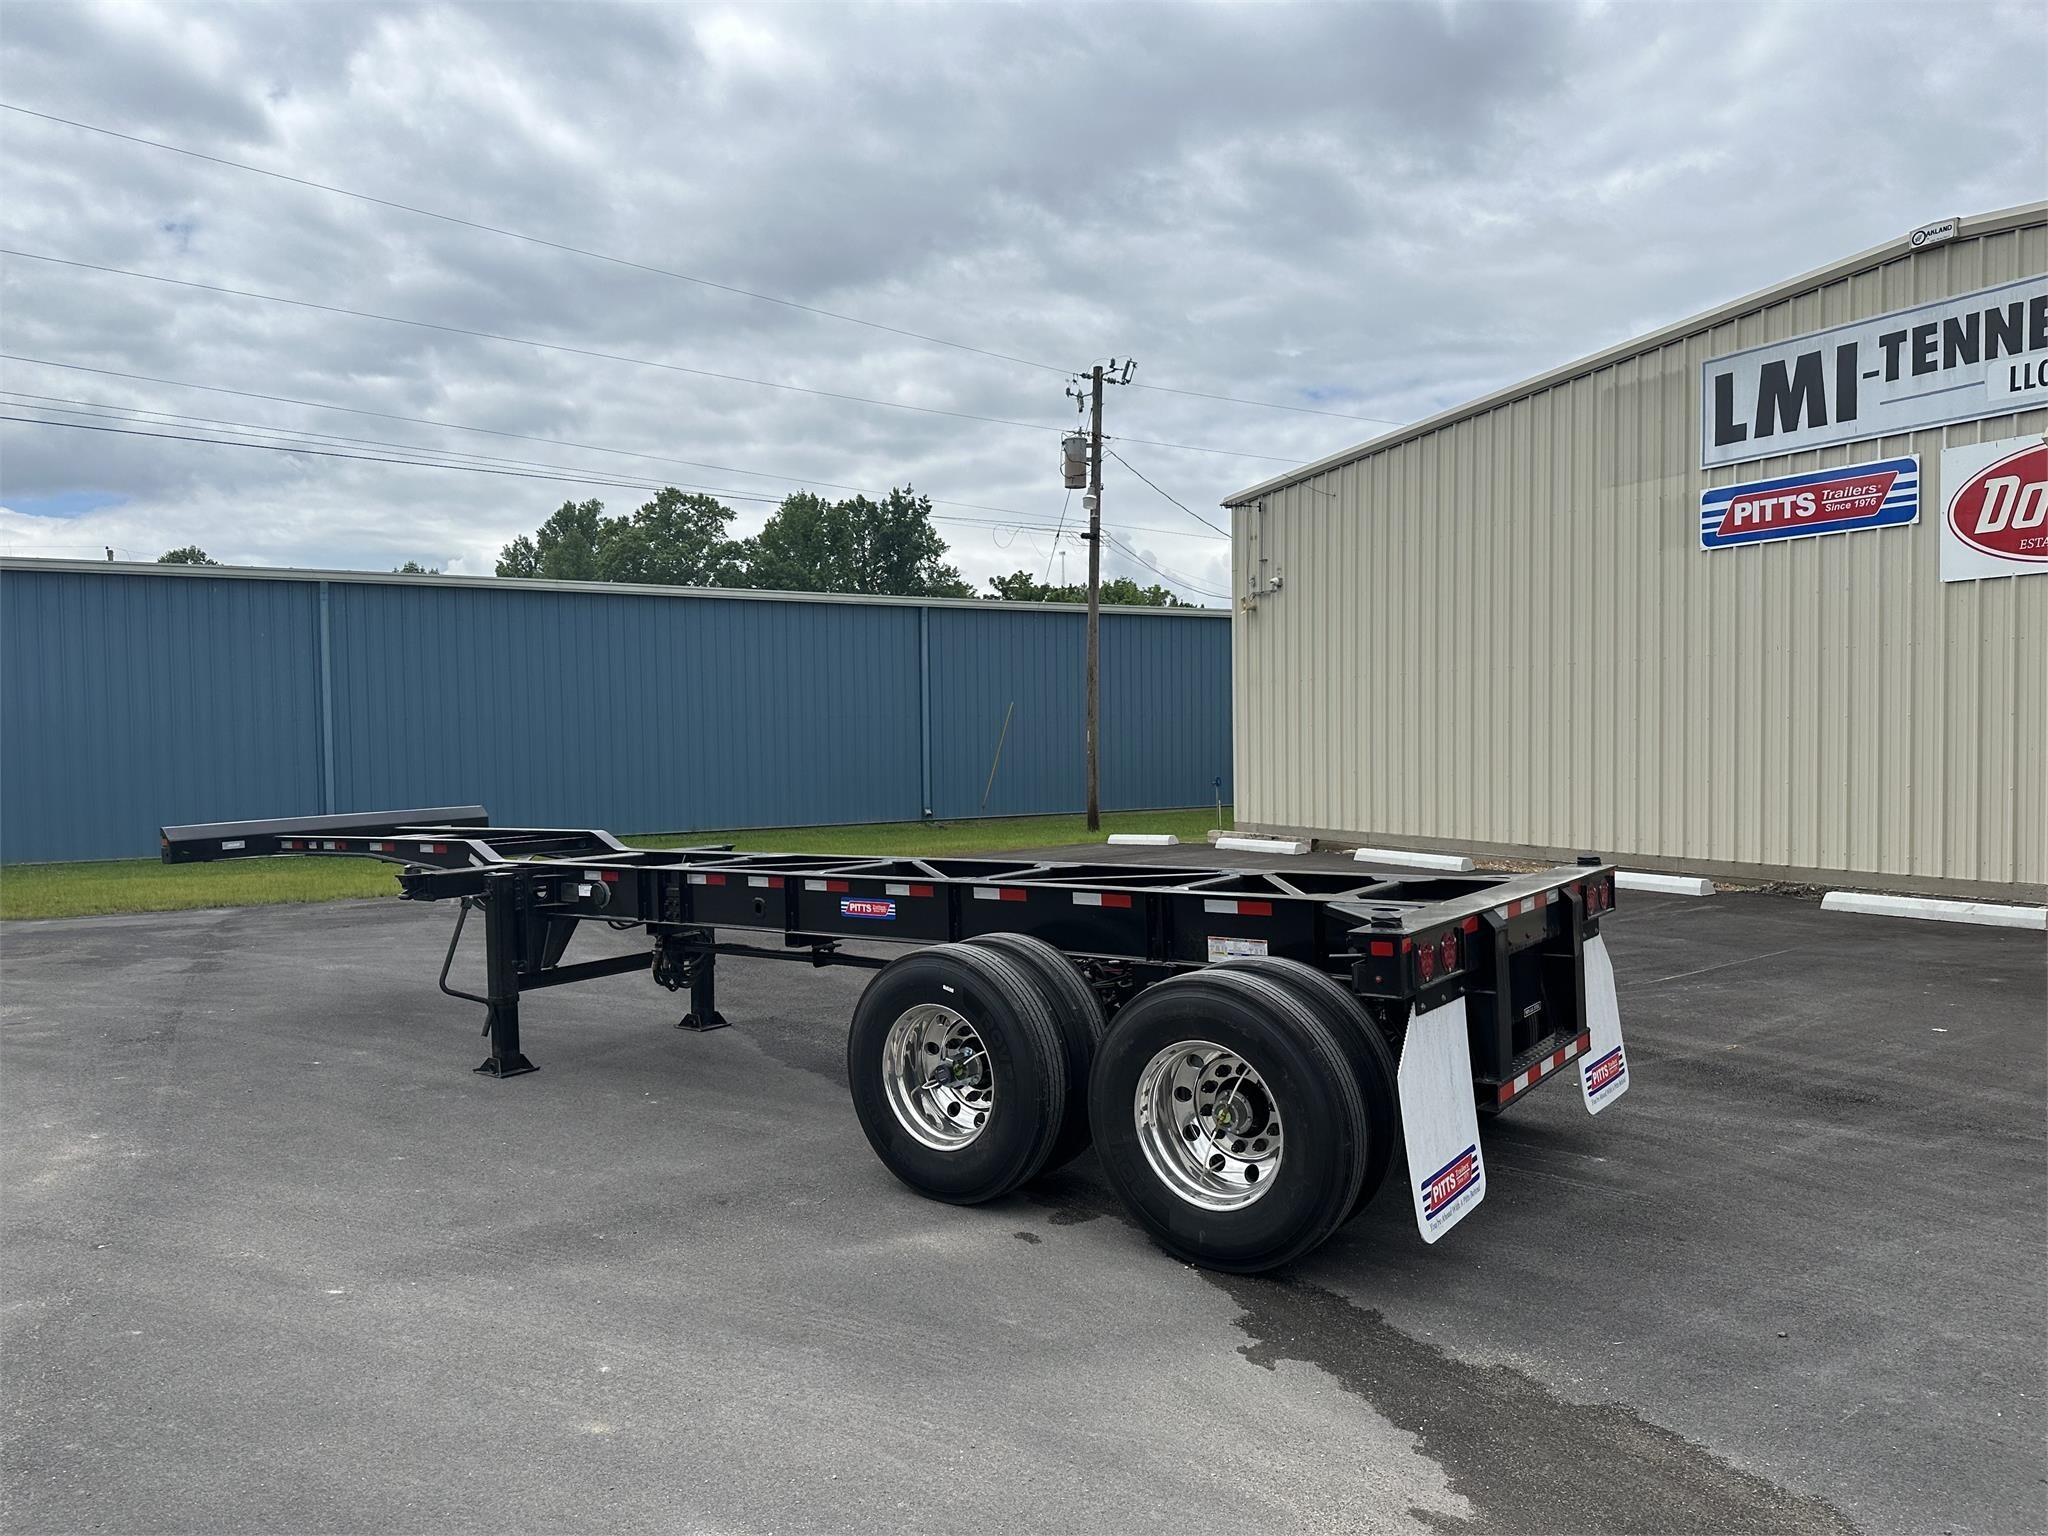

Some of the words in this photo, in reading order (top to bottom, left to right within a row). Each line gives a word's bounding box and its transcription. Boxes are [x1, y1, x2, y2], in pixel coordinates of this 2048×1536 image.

[1911, 225, 1953, 246] OAKLAND
[1733, 492, 1816, 526] PITTS
[1821, 484, 1878, 500] Trailers
[1825, 502, 1852, 512] Since
[1854, 497, 1877, 508] 1976
[850, 903, 872, 912] PITTS
[1592, 1063, 1609, 1085] PITTS
[1432, 1173, 1456, 1203] PITTS
